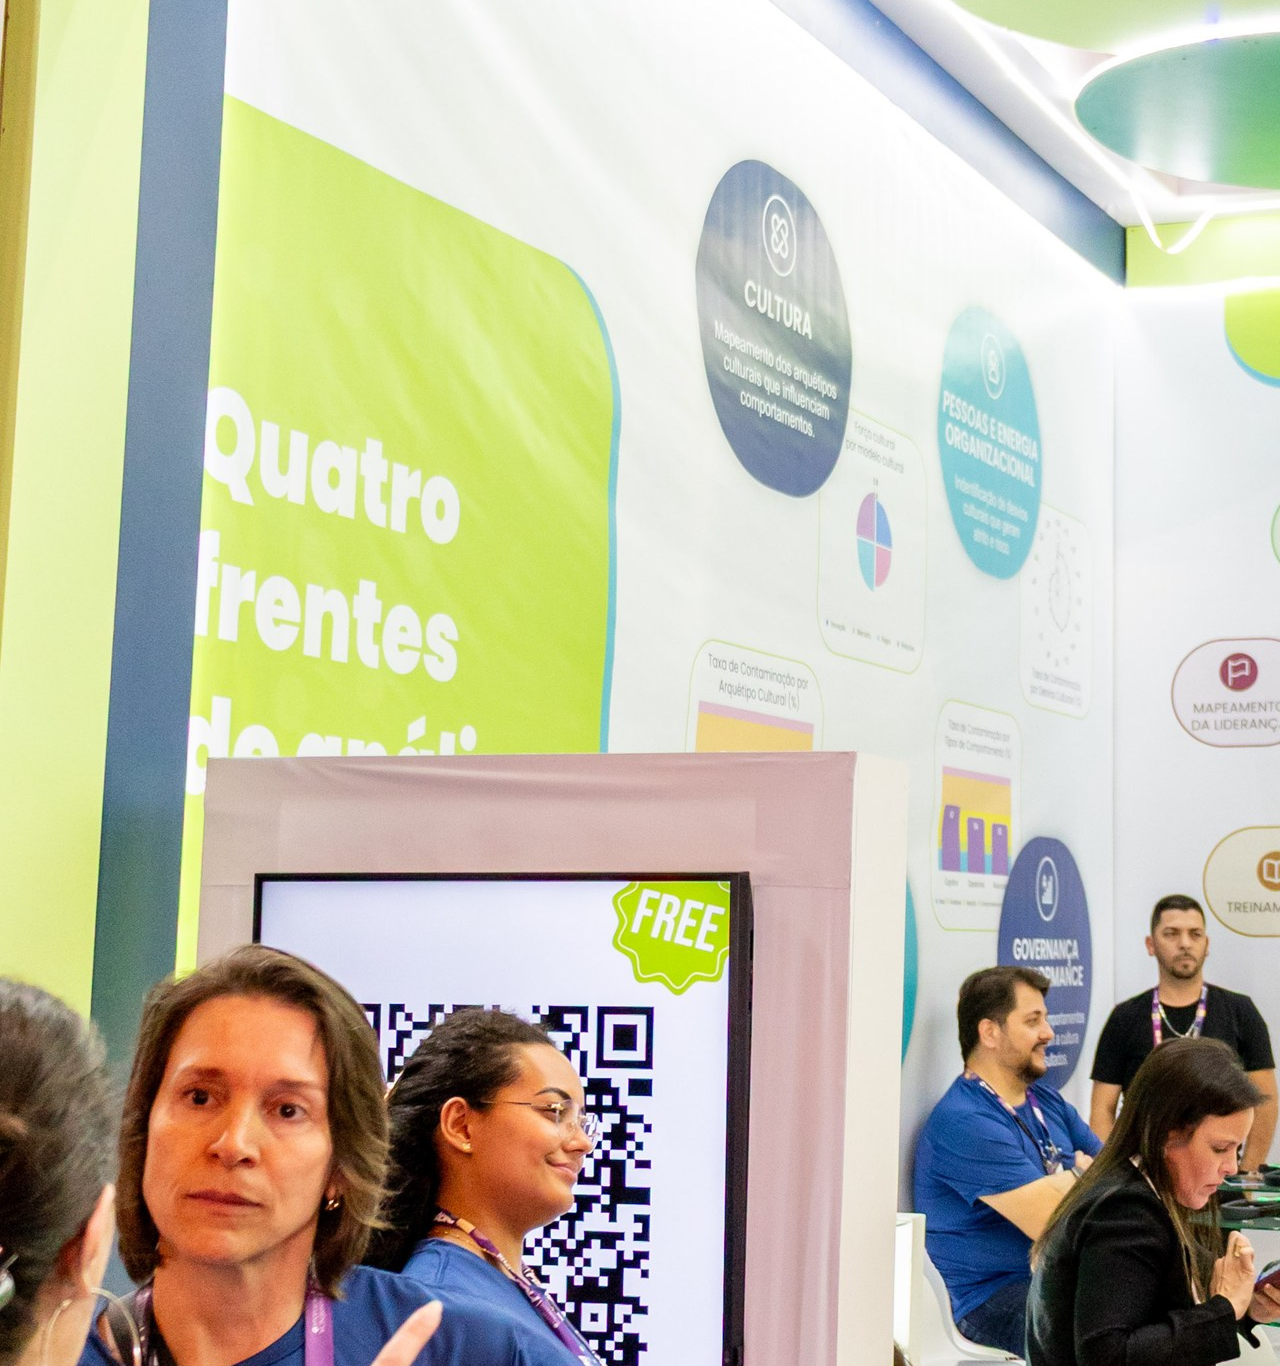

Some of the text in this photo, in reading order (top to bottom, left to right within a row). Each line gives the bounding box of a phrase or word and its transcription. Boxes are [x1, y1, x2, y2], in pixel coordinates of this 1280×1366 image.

[744, 280, 813, 340] CULTURA
[714, 319, 837, 401] Mapeamento dos arquétipos
[723, 355, 830, 422] culturais que influenciam
[942, 388, 1039, 463] PESSOAS E ENERGIA
[945, 421, 1036, 489] ORGANIZACIONAL
[204, 386, 461, 545] Quatro
[194, 530, 460, 683] frentes
[708, 653, 809, 692] Taxa de Contaminação por
[718, 678, 757, 703] Arquétipo
[757, 688, 787, 707] Cultural
[1191, 720, 1210, 732] DA
[630, 888, 726, 953] FREE
[1012, 938, 1079, 966] GOVERNANÇA
